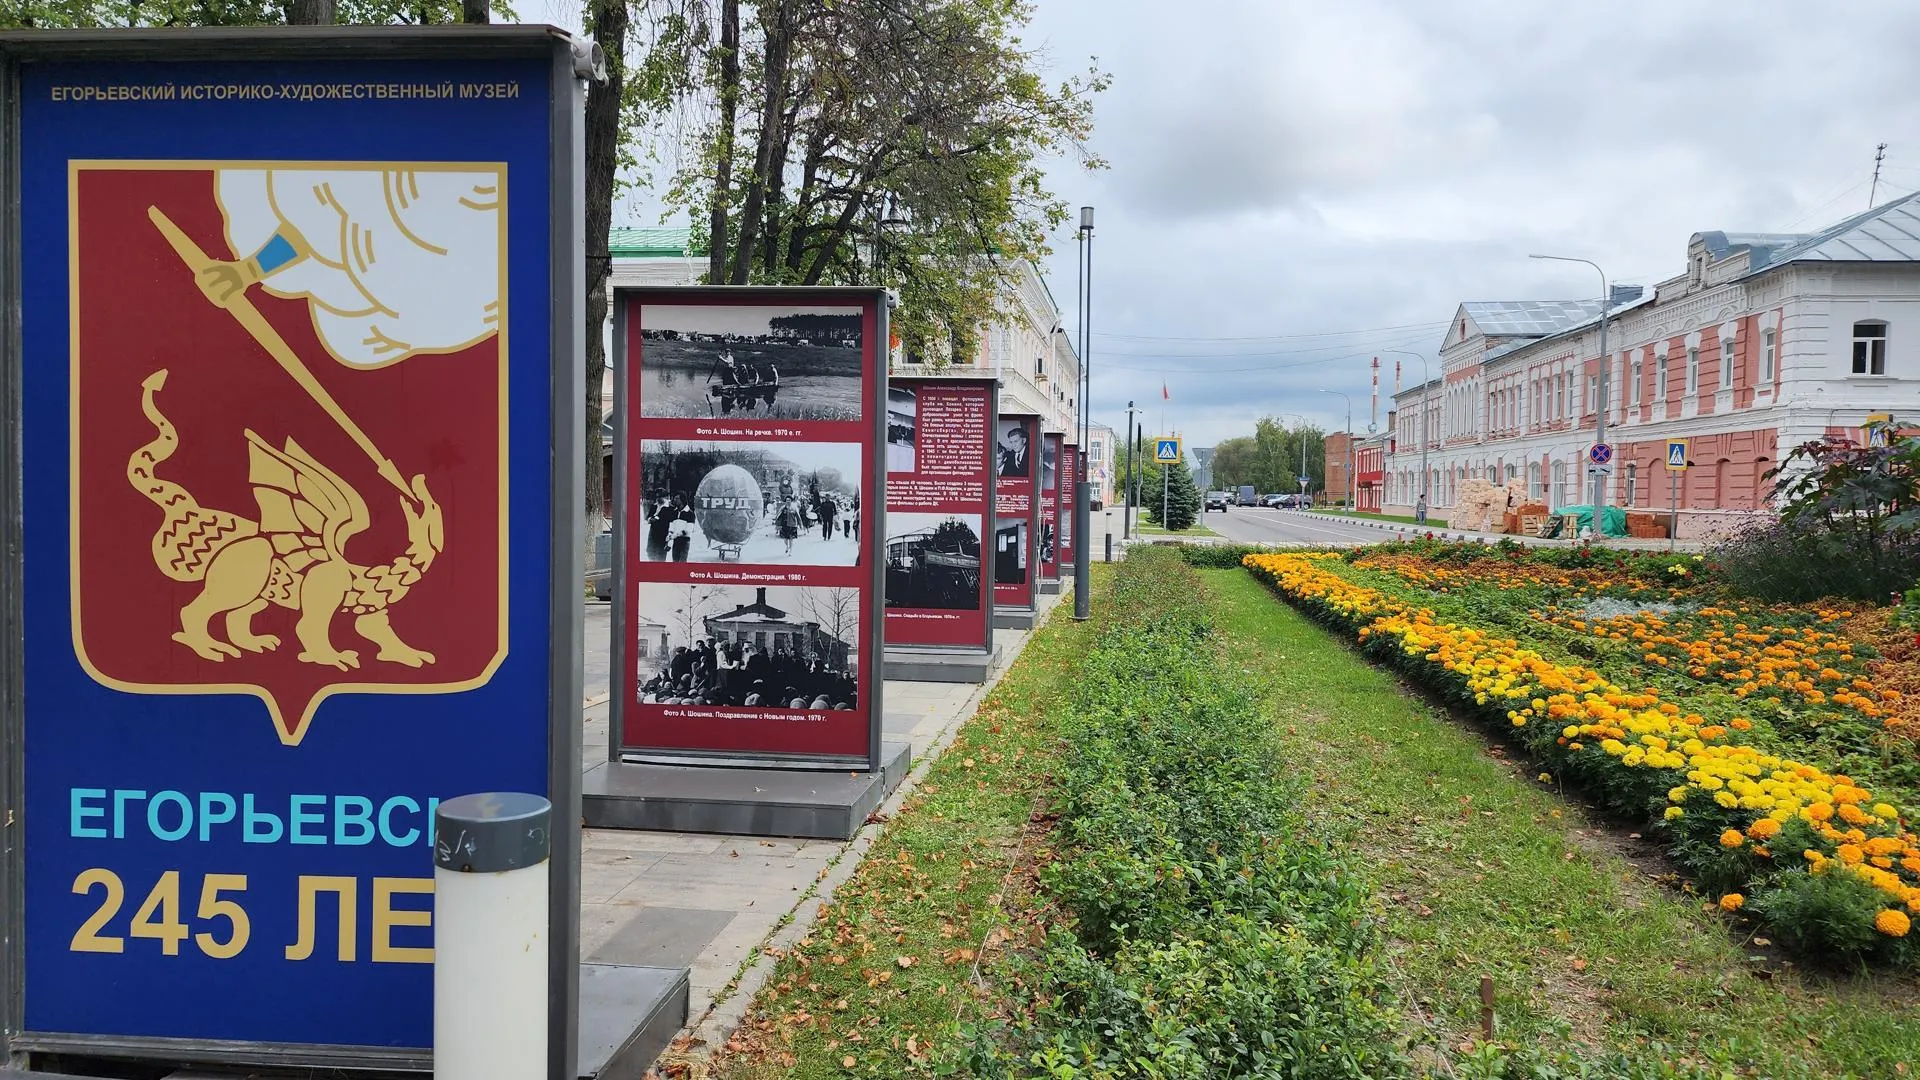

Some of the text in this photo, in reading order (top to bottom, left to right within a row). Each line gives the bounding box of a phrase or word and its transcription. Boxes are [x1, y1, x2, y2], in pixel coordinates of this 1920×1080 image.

[51, 79, 520, 101] ЕГОРЬЕВСКИЙ ИСТОРИКО-ХУДОЖЕСТВЕННЫЙ МУЗЕЙ
[696, 427, 712, 435] Фото
[745, 428, 753, 436] На
[754, 430, 772, 438] речке.
[774, 429, 788, 437] 1970
[701, 497, 751, 510] ТРУД
[690, 571, 705, 579] Фото
[706, 571, 713, 579] А.
[713, 572, 740, 580] Шошина.
[741, 573, 786, 581] Демонстрация.
[663, 709, 679, 717] Фото
[687, 710, 714, 718] Шошина.
[715, 711, 758, 720] Поздравление
[764, 713, 786, 721] Новым
[786, 714, 806, 722] годом.
[69, 866, 435, 965] 245 ЛЕ
